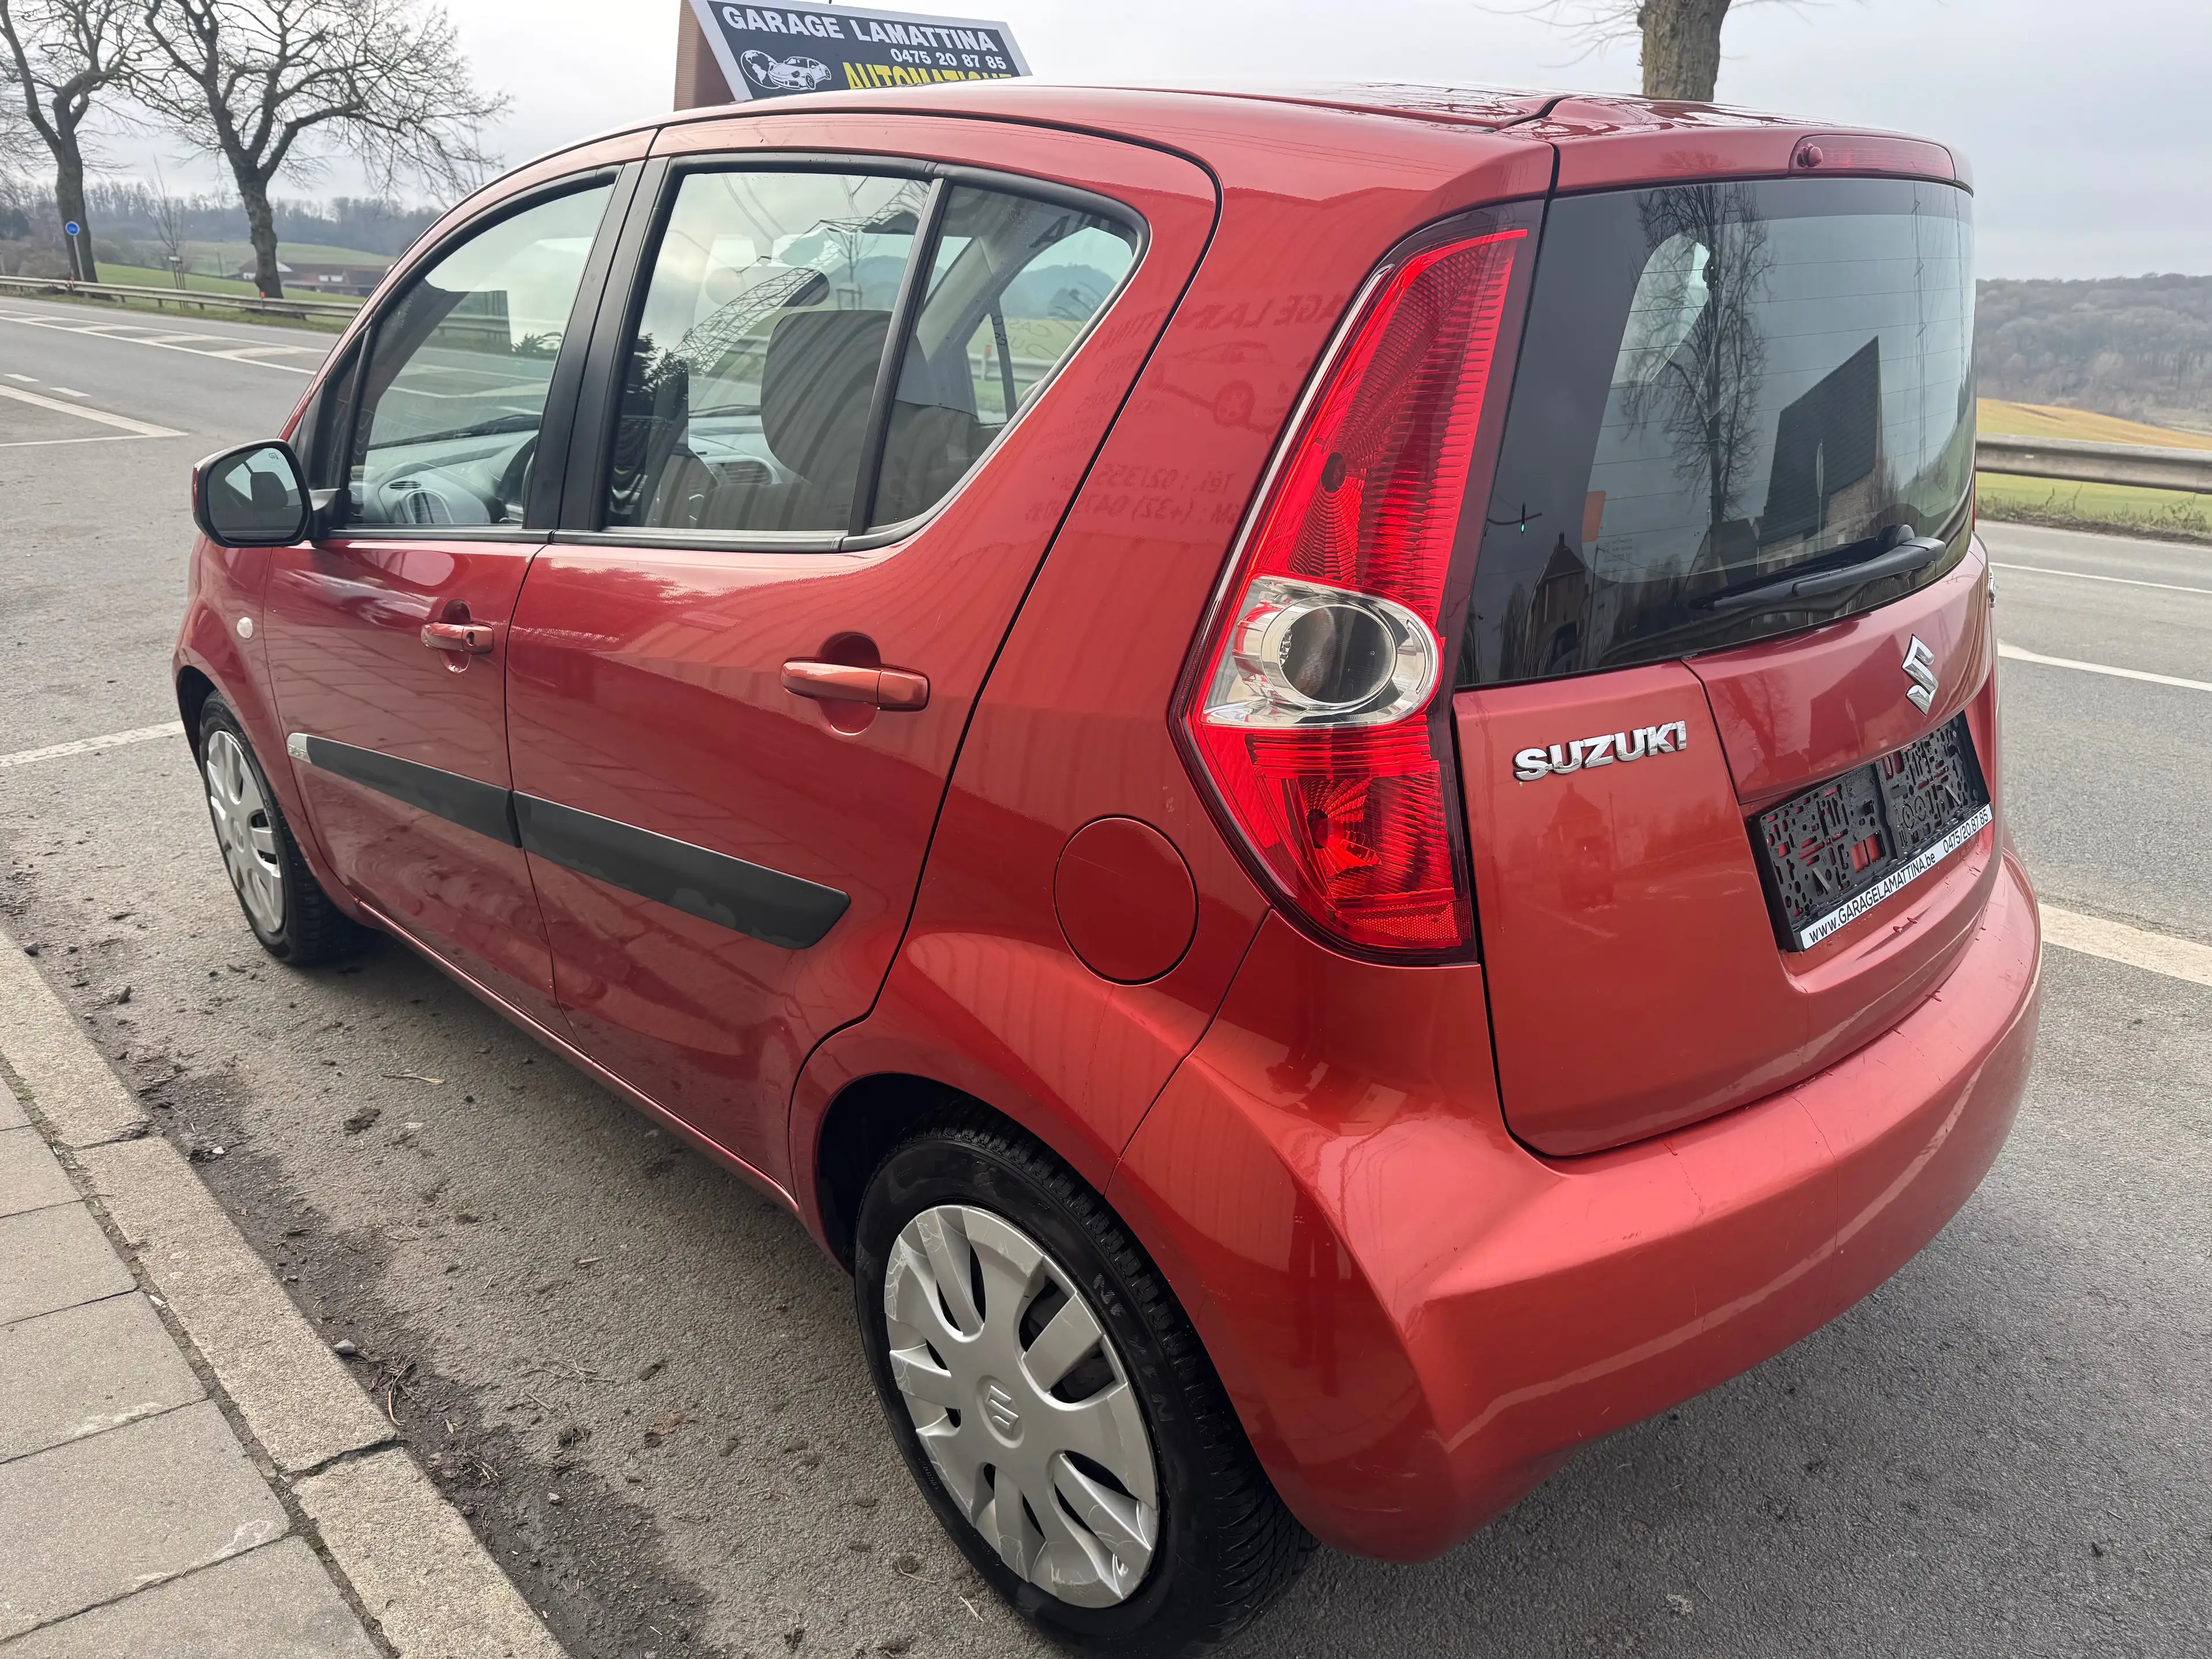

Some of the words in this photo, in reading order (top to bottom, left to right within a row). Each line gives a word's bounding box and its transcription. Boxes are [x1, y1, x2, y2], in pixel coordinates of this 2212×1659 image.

[722, 6, 845, 39] GARAGE
[849, 20, 999, 52] LAMATTINA
[890, 48, 932, 65] 0475
[935, 52, 957, 66] 20
[961, 54, 980, 68] 87
[985, 55, 1007, 70] 85
[1513, 720, 1687, 782] SUZUKI
[1809, 852, 1936, 944] www.GARAGELAMATTINA.be
[1943, 808, 1989, 854] 0475/20.87.85
